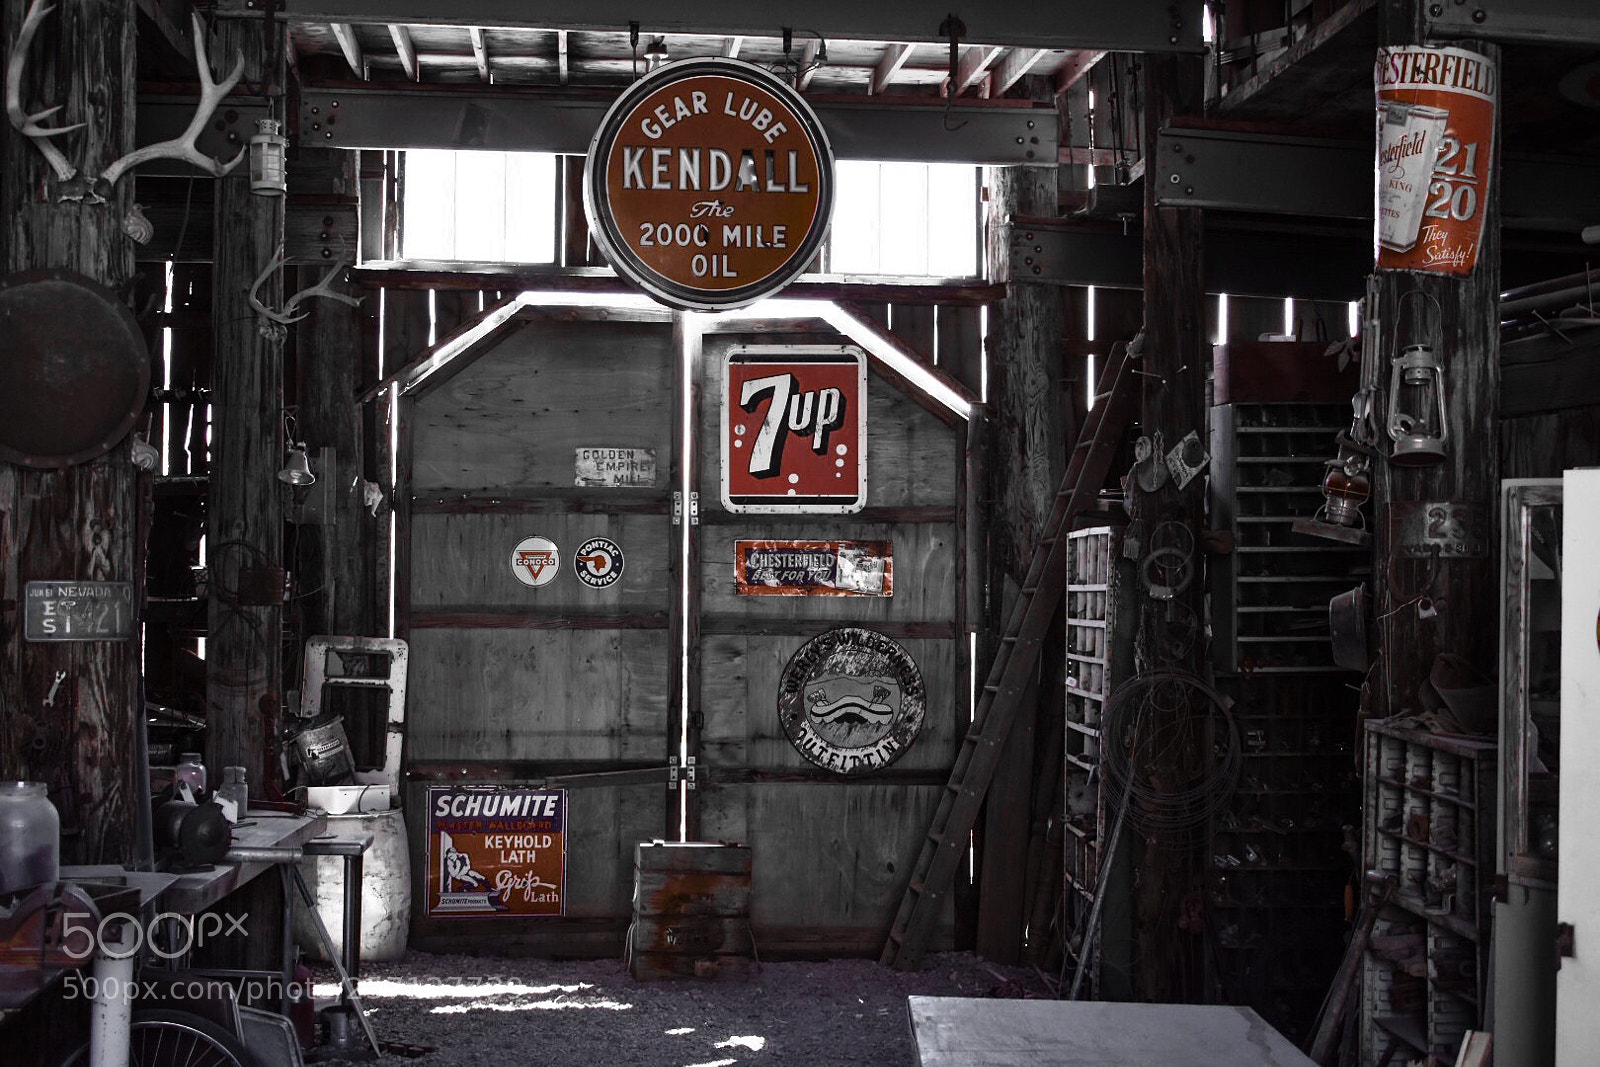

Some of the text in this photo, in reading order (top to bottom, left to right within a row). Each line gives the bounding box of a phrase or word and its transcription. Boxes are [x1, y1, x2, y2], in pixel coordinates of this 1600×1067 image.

[641, 91, 788, 144] GEAR LUBE
[1435, 137, 1478, 178] 21
[622, 146, 809, 193] KENDALL
[1389, 179, 1413, 193] KING
[690, 200, 735, 218] The
[1426, 182, 1477, 221] 20
[639, 223, 788, 248] 2000 MILE
[1422, 224, 1448, 247] They
[1422, 243, 1474, 267] Satisfy!
[691, 254, 738, 278] OIL
[583, 450, 635, 460] GOLDEN
[596, 461, 647, 471] EMPIRE
[580, 540, 619, 557] PONTIAC
[750, 551, 835, 569] CHESTERFIELD
[579, 570, 618, 585] SERVICE
[781, 570, 806, 582] FOR
[58, 586, 112, 598] NEVADA
[798, 727, 903, 770] OUTFITTIN
[435, 795, 559, 817] SCHUMITE
[484, 835, 552, 849] KEYHOLD
[501, 850, 536, 863] LATH
[531, 891, 559, 903] Lath
